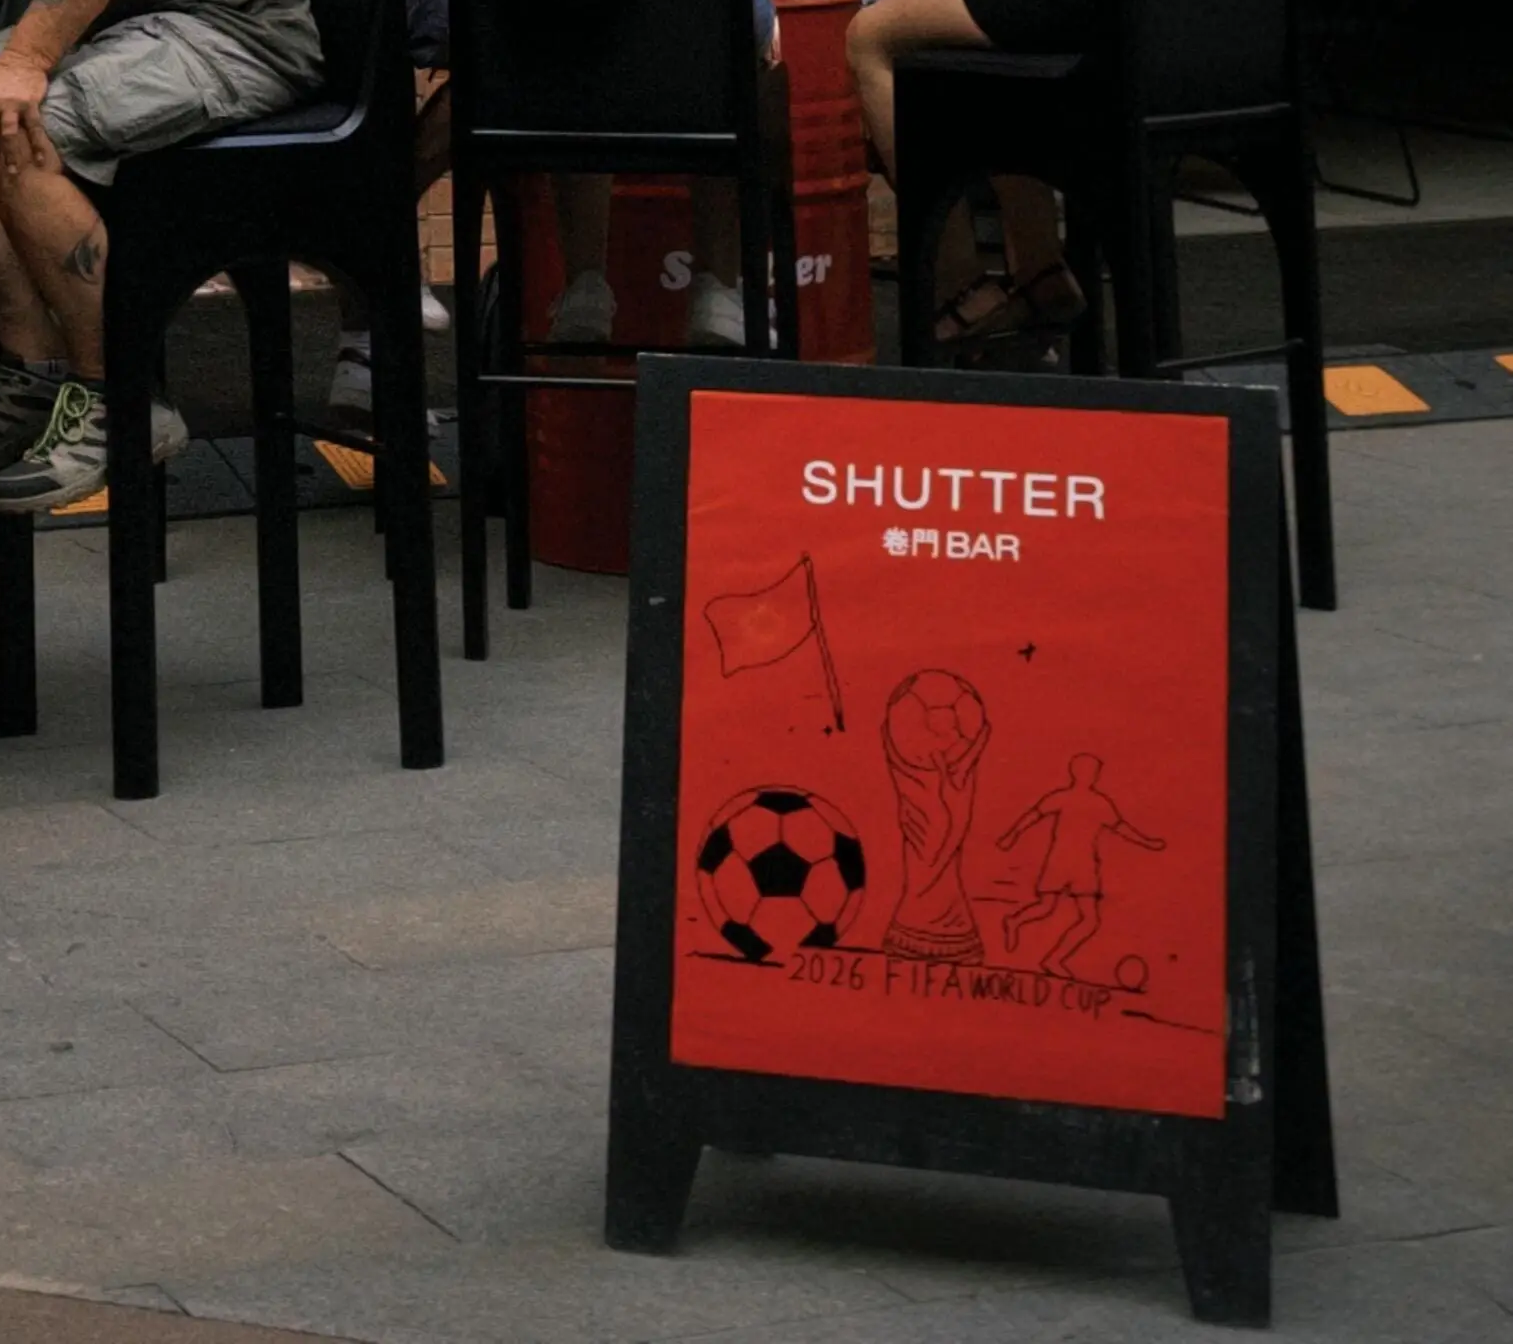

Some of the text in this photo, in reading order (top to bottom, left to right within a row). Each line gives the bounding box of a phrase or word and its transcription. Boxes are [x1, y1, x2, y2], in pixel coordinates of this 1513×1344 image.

[801, 459, 1106, 520] SHUTTER
[945, 529, 1021, 562] BAR
[788, 953, 1112, 1020] 2026 FIFA WORLD CUP
